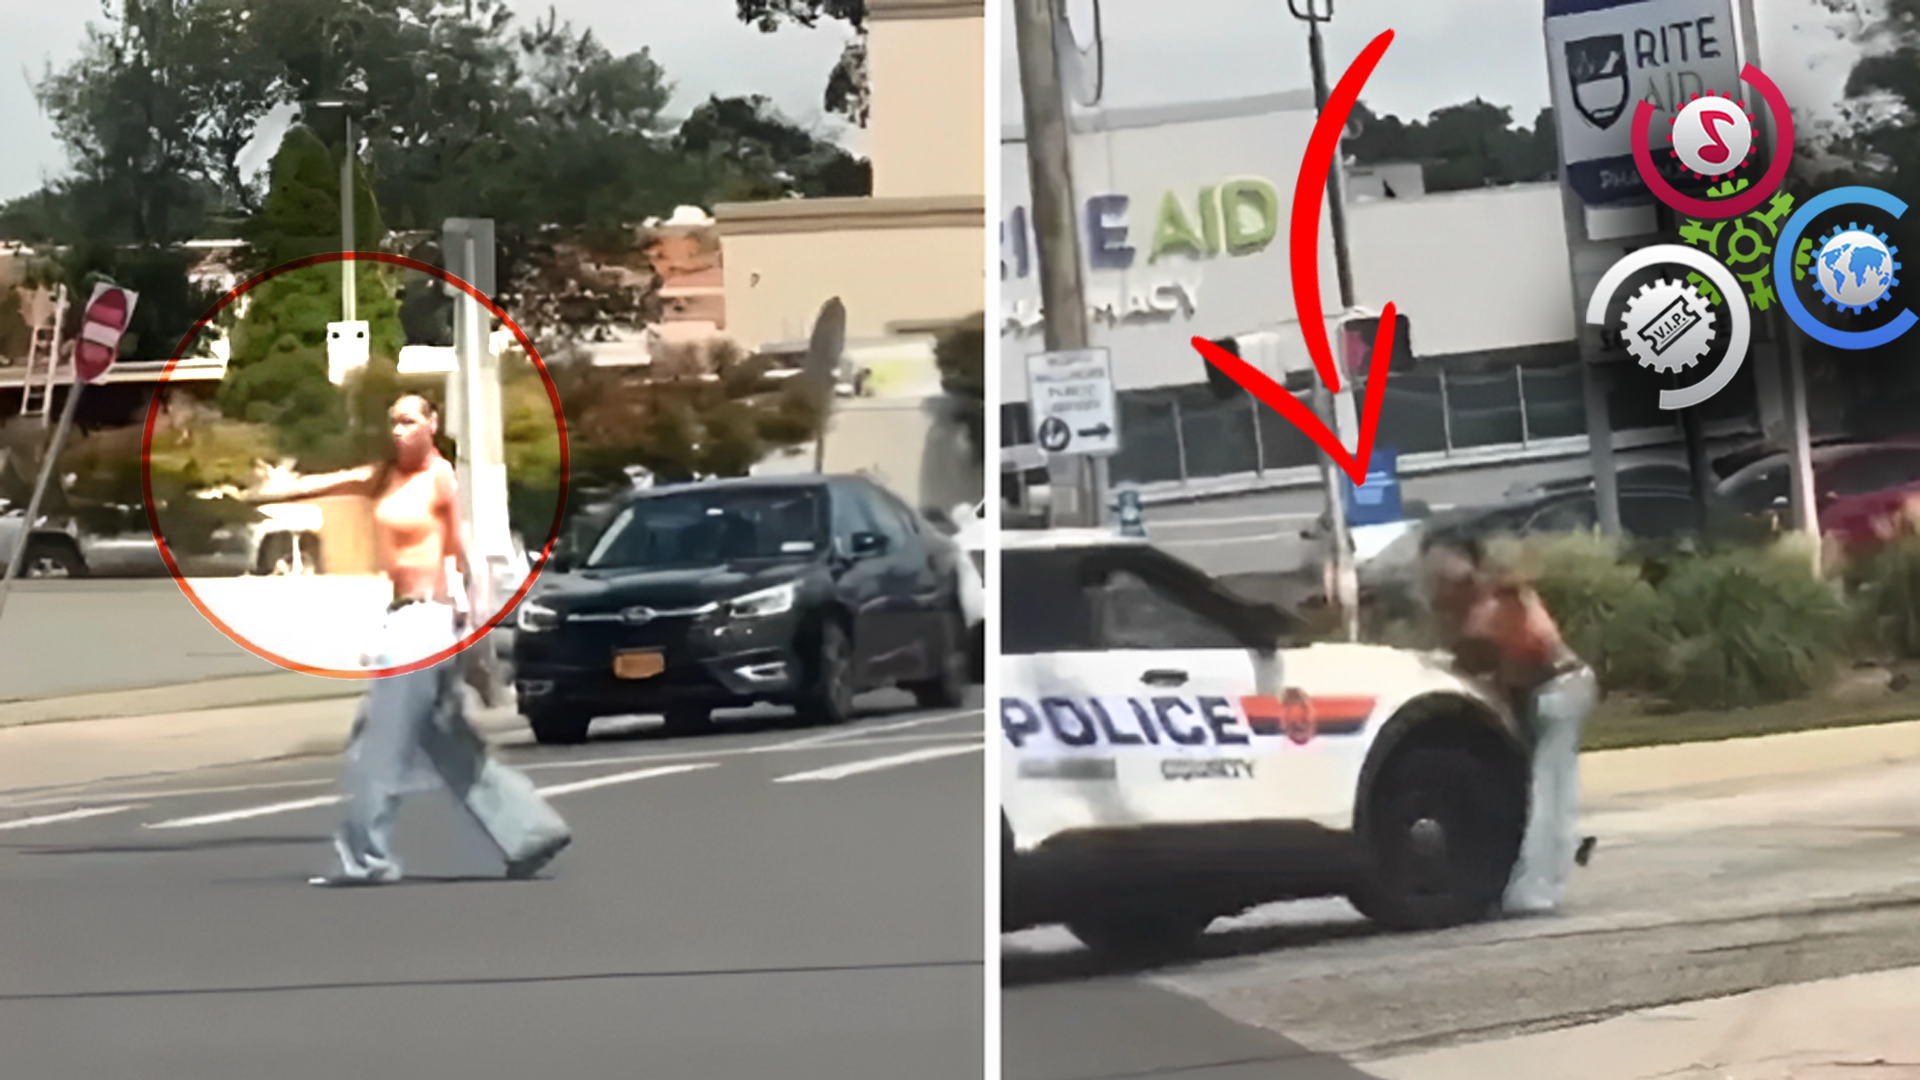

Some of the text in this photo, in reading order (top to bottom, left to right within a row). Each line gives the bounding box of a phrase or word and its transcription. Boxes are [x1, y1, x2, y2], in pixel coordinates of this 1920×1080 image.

[1634, 16, 1721, 69] RITE
[1643, 71, 1704, 114] AID
[1147, 176, 1279, 265] AID
[1001, 696, 1250, 747] POLICE
